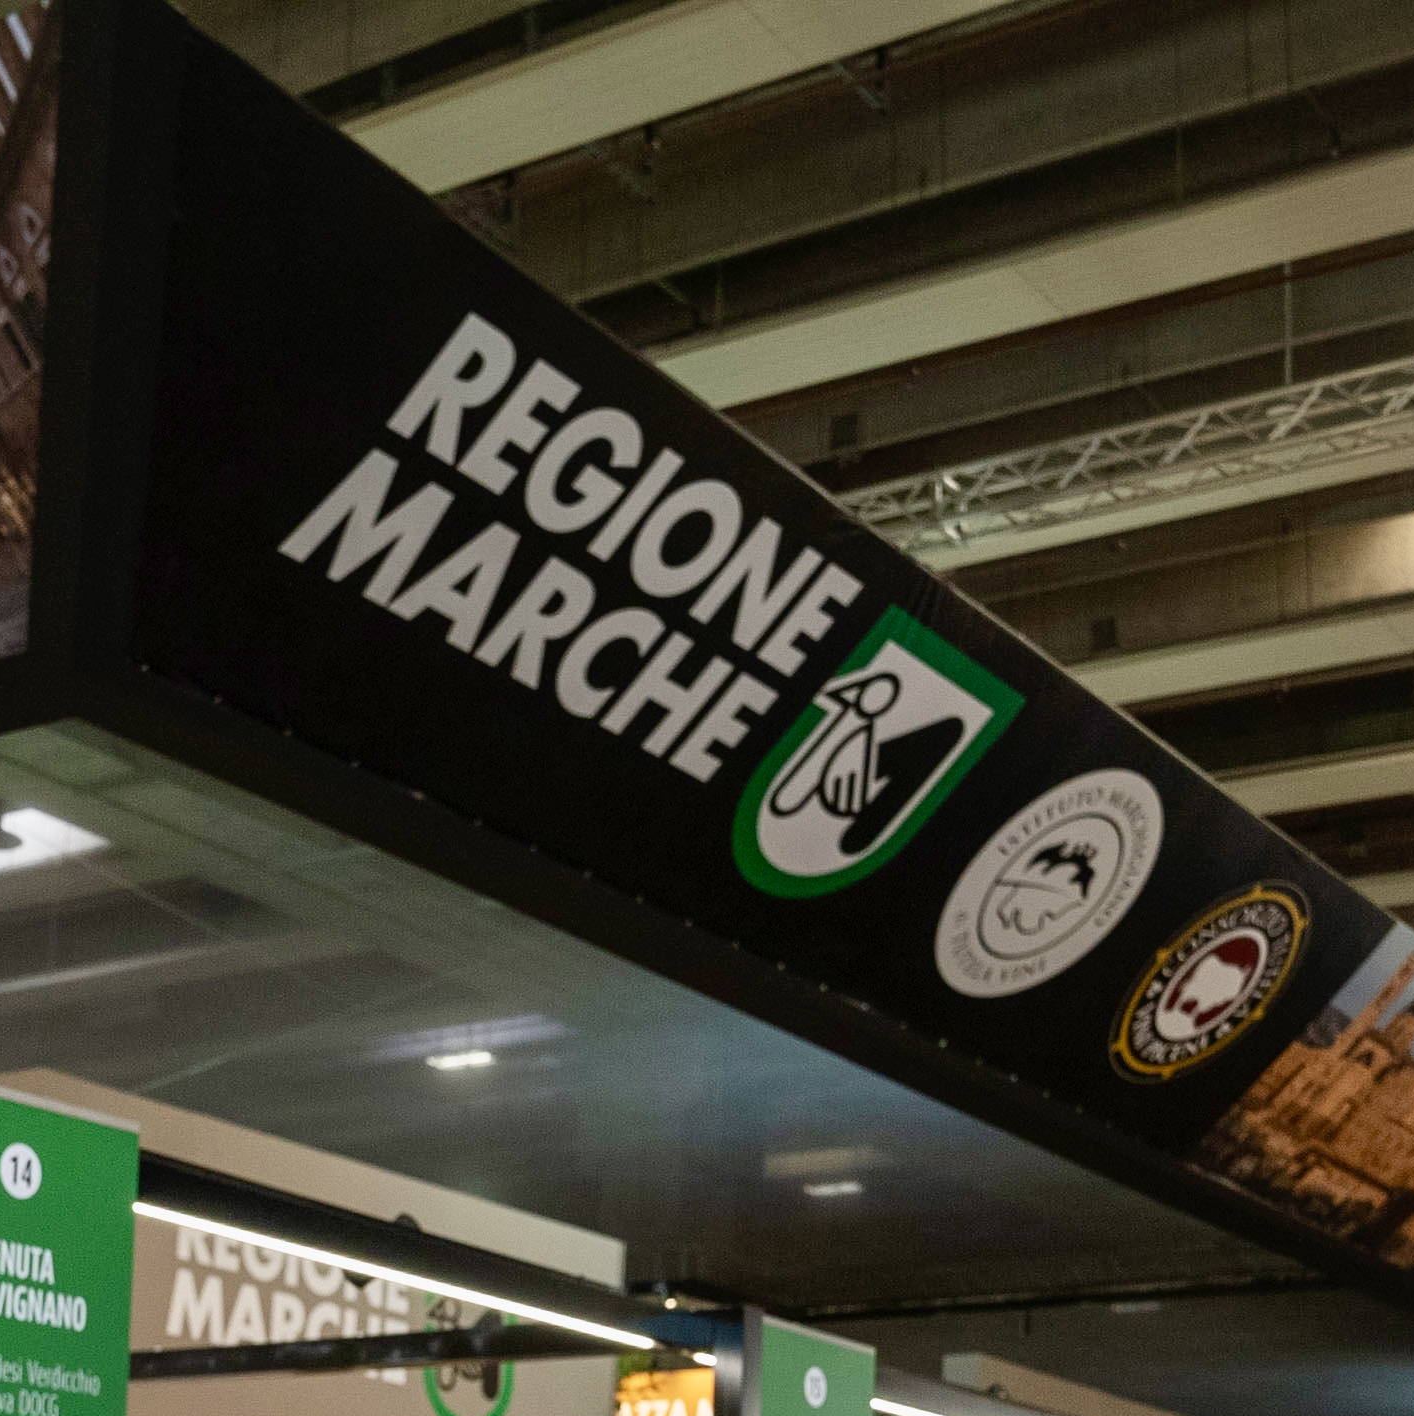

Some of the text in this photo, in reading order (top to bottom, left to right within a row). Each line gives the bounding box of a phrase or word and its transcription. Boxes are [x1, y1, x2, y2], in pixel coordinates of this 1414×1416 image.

[388, 311, 863, 677] REGIONE
[278, 447, 779, 783] MARCHE
[10, 1156, 32, 1188] 14
[26, 1357, 101, 1398] Verdicchio
